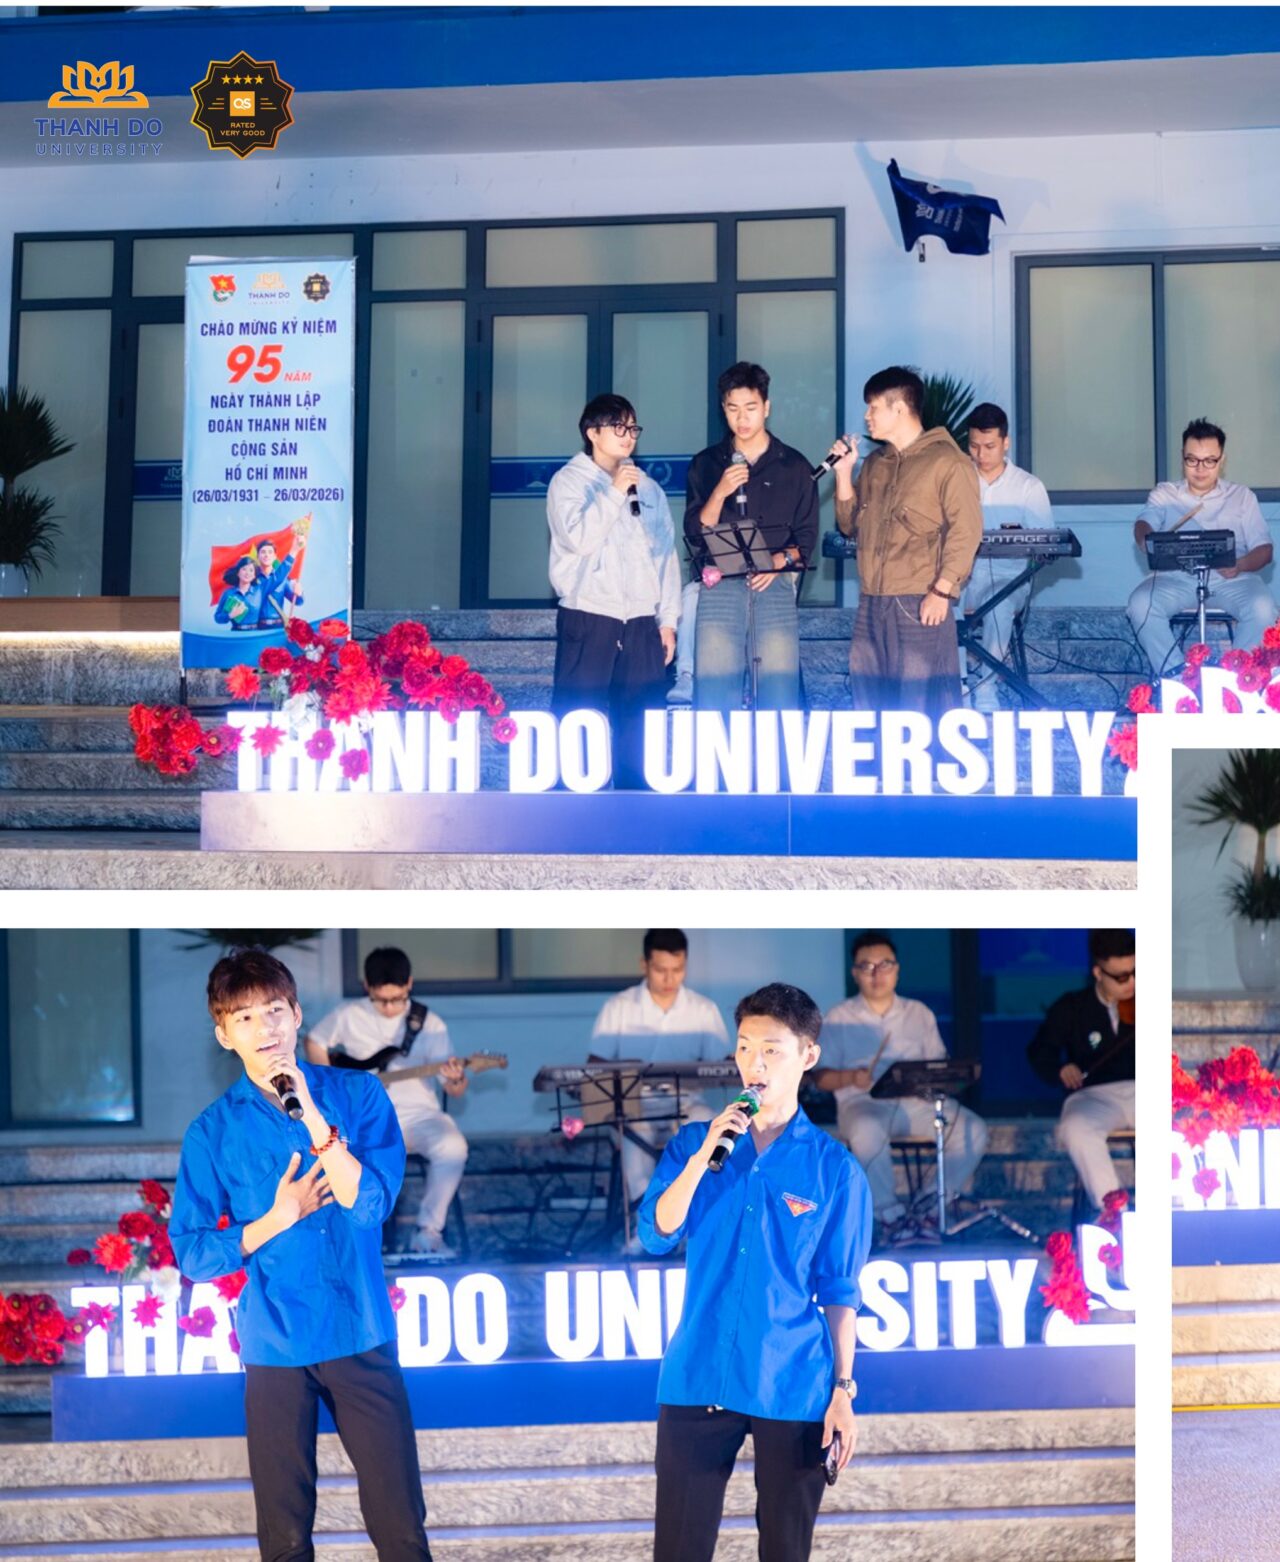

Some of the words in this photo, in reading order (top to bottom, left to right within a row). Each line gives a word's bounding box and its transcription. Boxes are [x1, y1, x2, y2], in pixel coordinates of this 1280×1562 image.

[200, 319, 234, 337] CHÀO
[282, 316, 298, 335] KỶ
[303, 317, 337, 337] NIỆM
[226, 345, 283, 383] 95
[284, 370, 312, 381] NĂM
[211, 392, 244, 408] NGÀY
[249, 391, 291, 408] THÀNH
[296, 390, 321, 410] LẬP
[208, 417, 243, 433] ĐOÀN
[248, 418, 290, 432] THANH
[295, 415, 327, 431] NIÊN
[231, 440, 266, 460] CỘNG
[271, 438, 298, 456] SẢN
[247, 463, 268, 480] CHÍ
[273, 466, 308, 480] MINH
[192, 488, 259, 504] (26/03/1931
[273, 487, 345, 503] 26/03/2026)
[982, 534, 1047, 543] ONTAGE
[508, 709, 612, 794] DO
[643, 708, 1118, 797] UNIVERSITY
[71, 1282, 246, 1377] THA
[395, 1273, 509, 1368] DO
